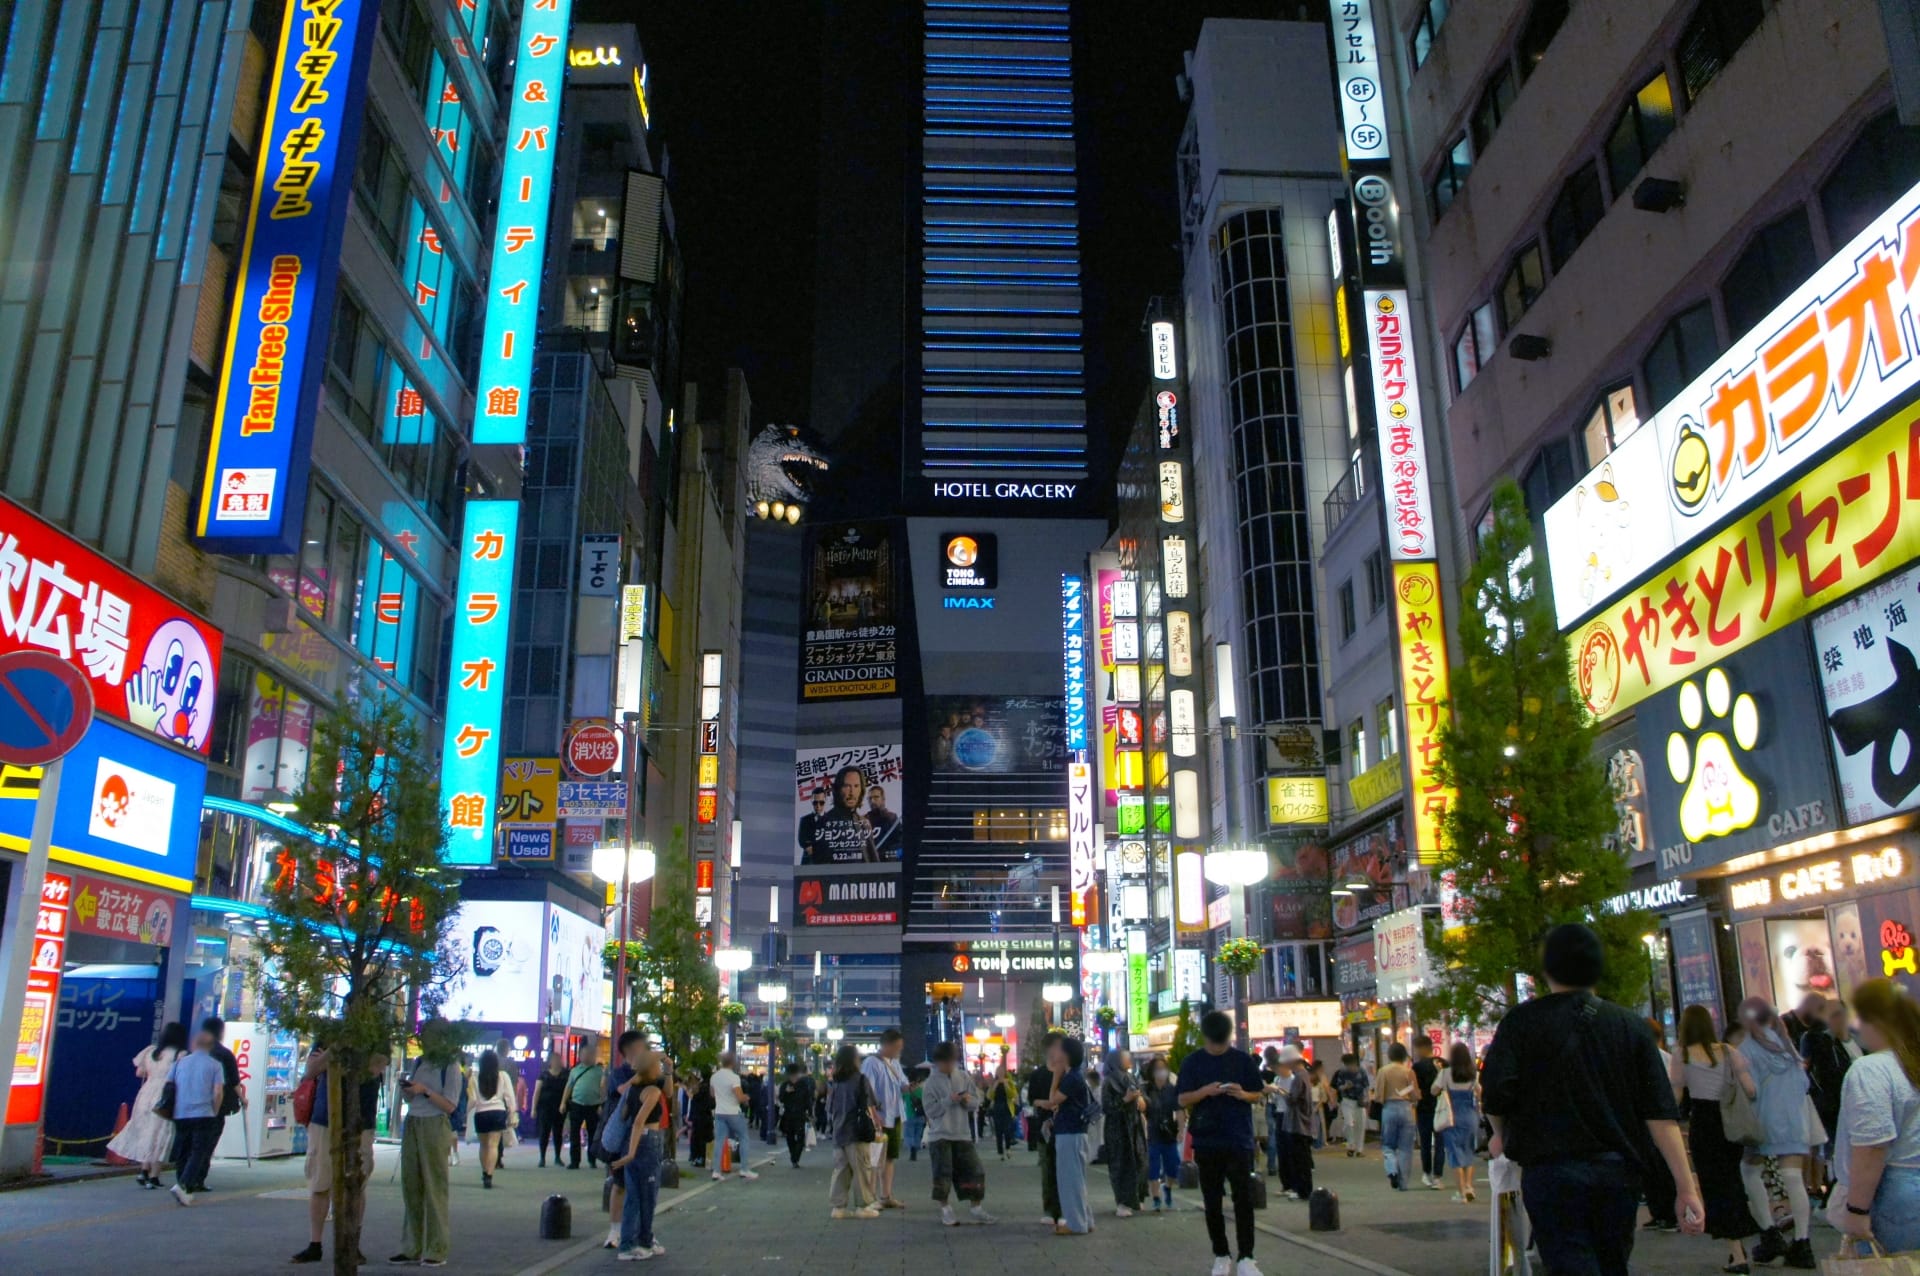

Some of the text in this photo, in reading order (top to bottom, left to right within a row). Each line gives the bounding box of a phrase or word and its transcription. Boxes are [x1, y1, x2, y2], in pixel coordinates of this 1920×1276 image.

[570, 47, 621, 66] all
[1351, 83, 1371, 96] 8F
[1357, 129, 1375, 143] 5F
[1355, 175, 1393, 266] Booth
[241, 255, 301, 436] Tax Free Shop
[1157, 332, 1171, 374] 東京ビル
[1374, 313, 1423, 557] カラオケ まねきねこ
[933, 483, 1077, 499] HOTEL GRACERY
[227, 494, 265, 511] 免税
[947, 569, 975, 578] TOHO
[947, 577, 985, 586] CINEMAS
[944, 597, 993, 609] IMAX
[806, 645, 844, 657] ワーナー
[1065, 580, 1086, 745] 747 カラオケランド
[450, 531, 504, 829] カラオケ館
[805, 666, 895, 683] GRAND OPEN
[574, 742, 615, 760] 消火栓
[796, 745, 893, 776] 超絶アクション
[576, 783, 626, 800] セキネ
[1767, 800, 1827, 837] CAFE
[510, 830, 550, 842] New&
[815, 827, 881, 842] ジョン・ウィック
[1072, 785, 1091, 890] マルハン
[513, 845, 549, 856] Used
[1661, 842, 1693, 870] INU
[829, 882, 895, 901] MARUHAN
[1731, 877, 1773, 911] INU
[1779, 862, 1845, 902] CAFE
[80, 898, 96, 913] 入口
[98, 886, 143, 914] カラオケ
[96, 908, 140, 936] 歌広場
[1879, 918, 1911, 950] Rio
[60, 981, 125, 1006] コイン
